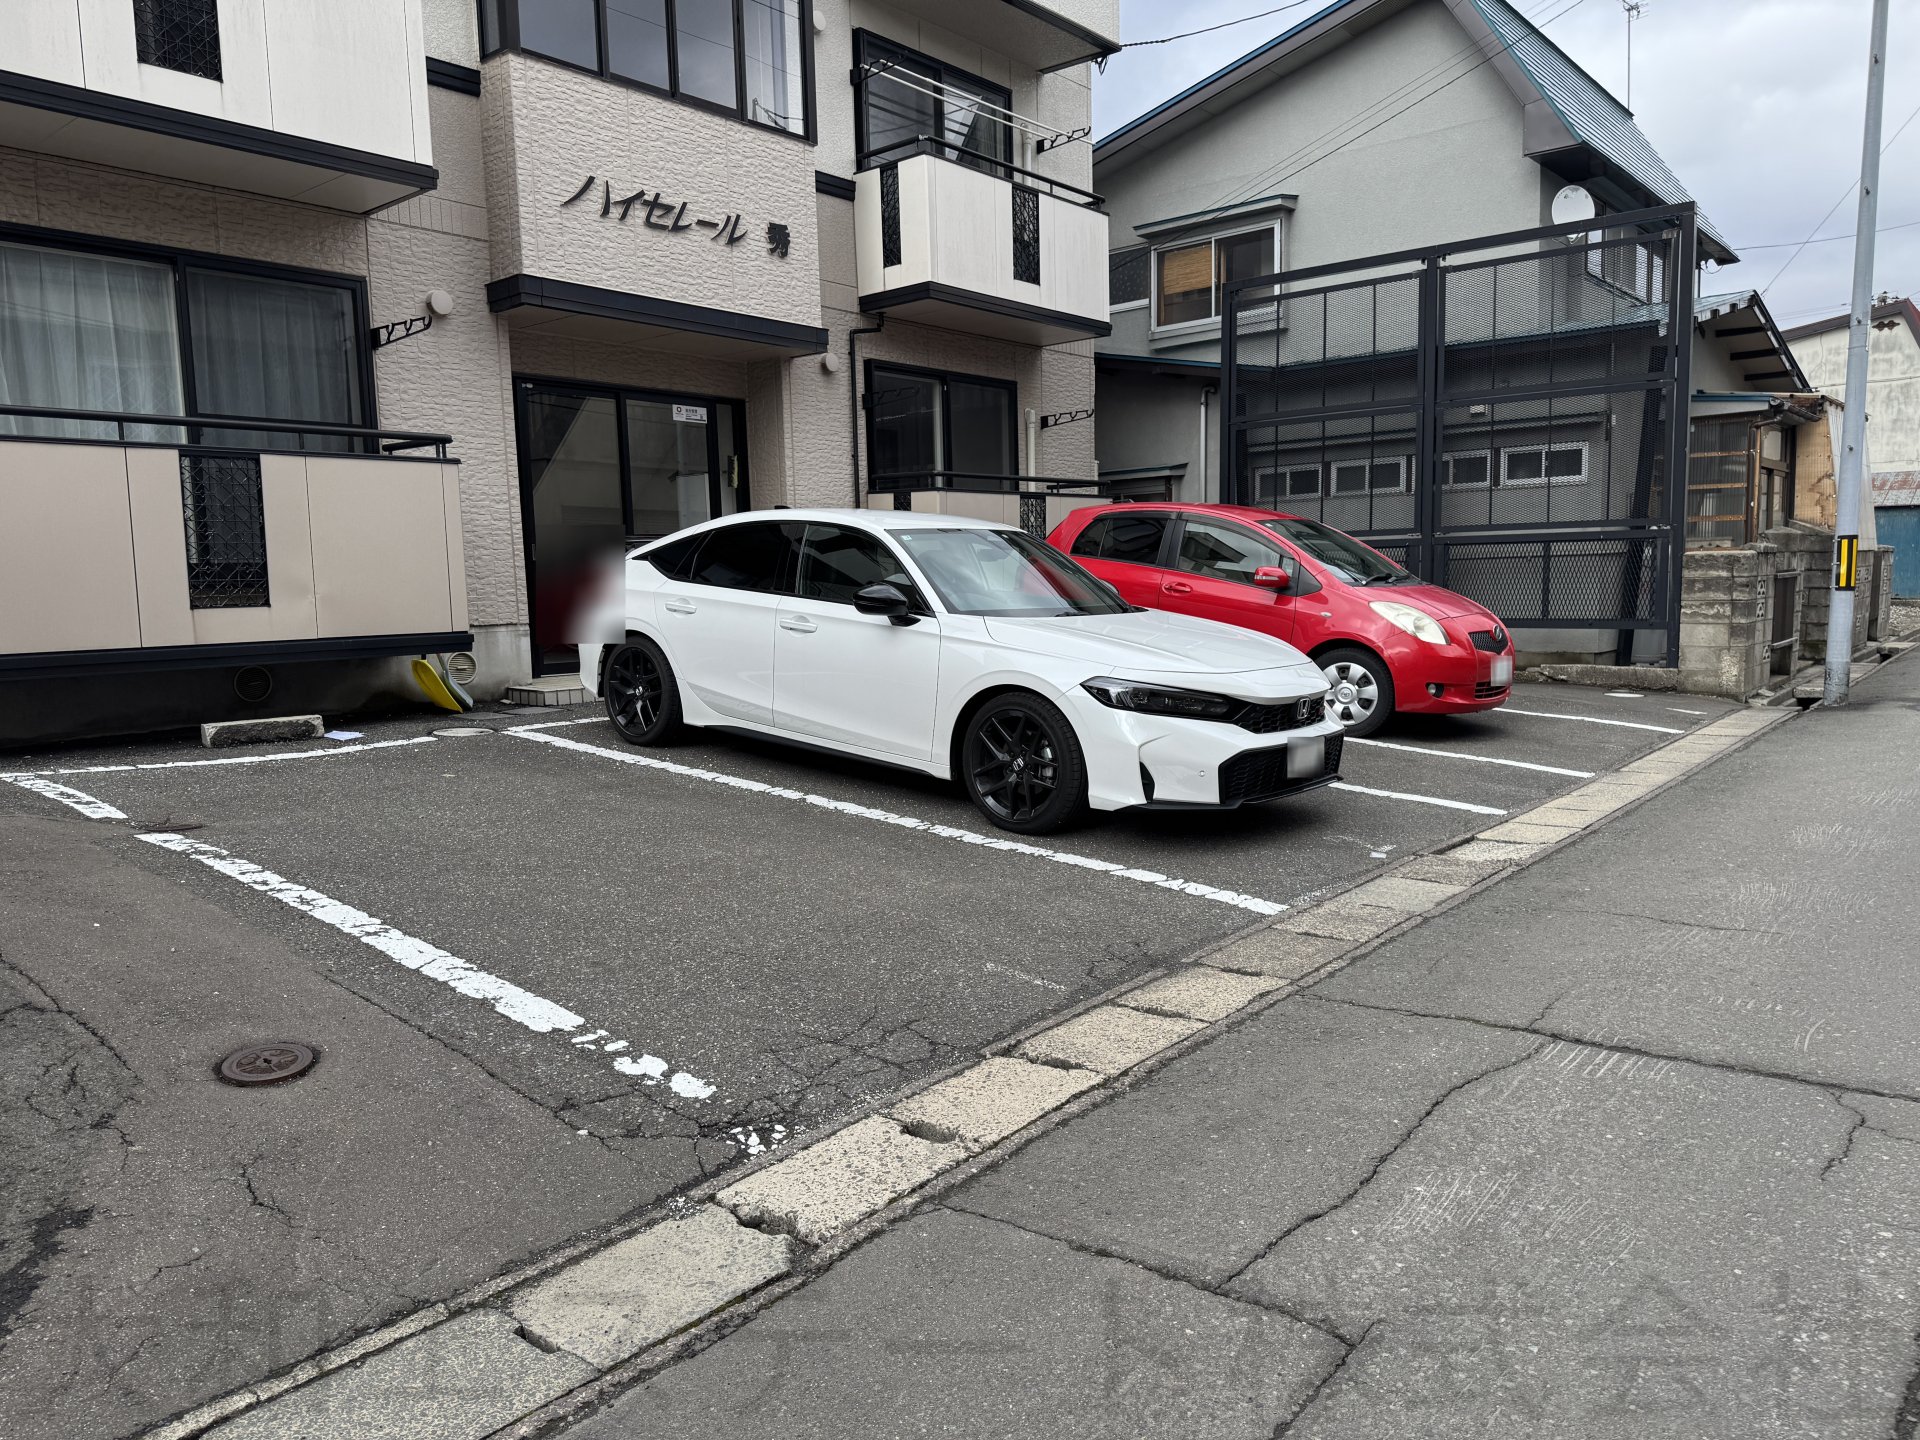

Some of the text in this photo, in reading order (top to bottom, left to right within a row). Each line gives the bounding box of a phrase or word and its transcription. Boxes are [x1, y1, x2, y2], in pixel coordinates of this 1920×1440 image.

[561, 175, 790, 258] ハイセレール 秀
